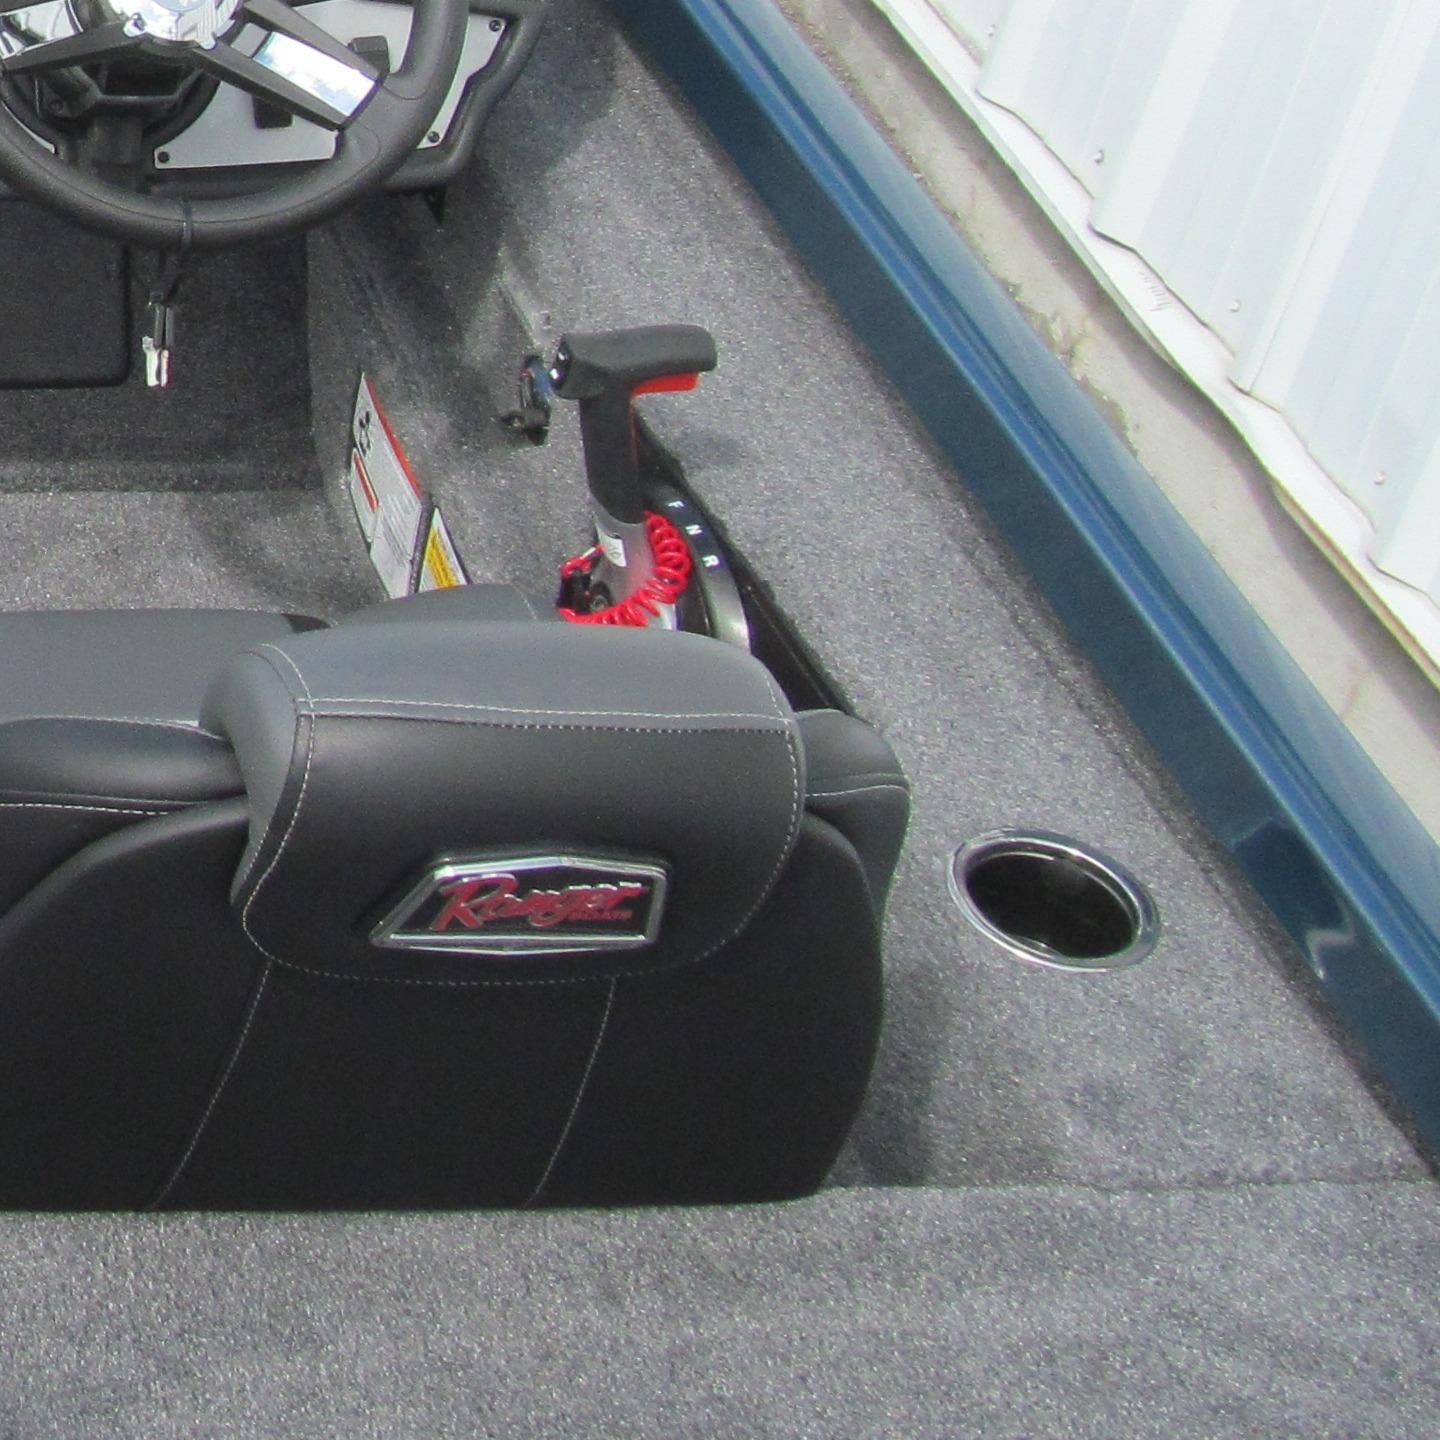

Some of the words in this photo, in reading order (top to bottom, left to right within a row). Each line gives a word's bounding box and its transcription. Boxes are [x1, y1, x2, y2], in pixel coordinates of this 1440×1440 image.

[685, 524, 703, 535] N
[702, 554, 720, 568] R
[429, 873, 650, 931] Ranger
